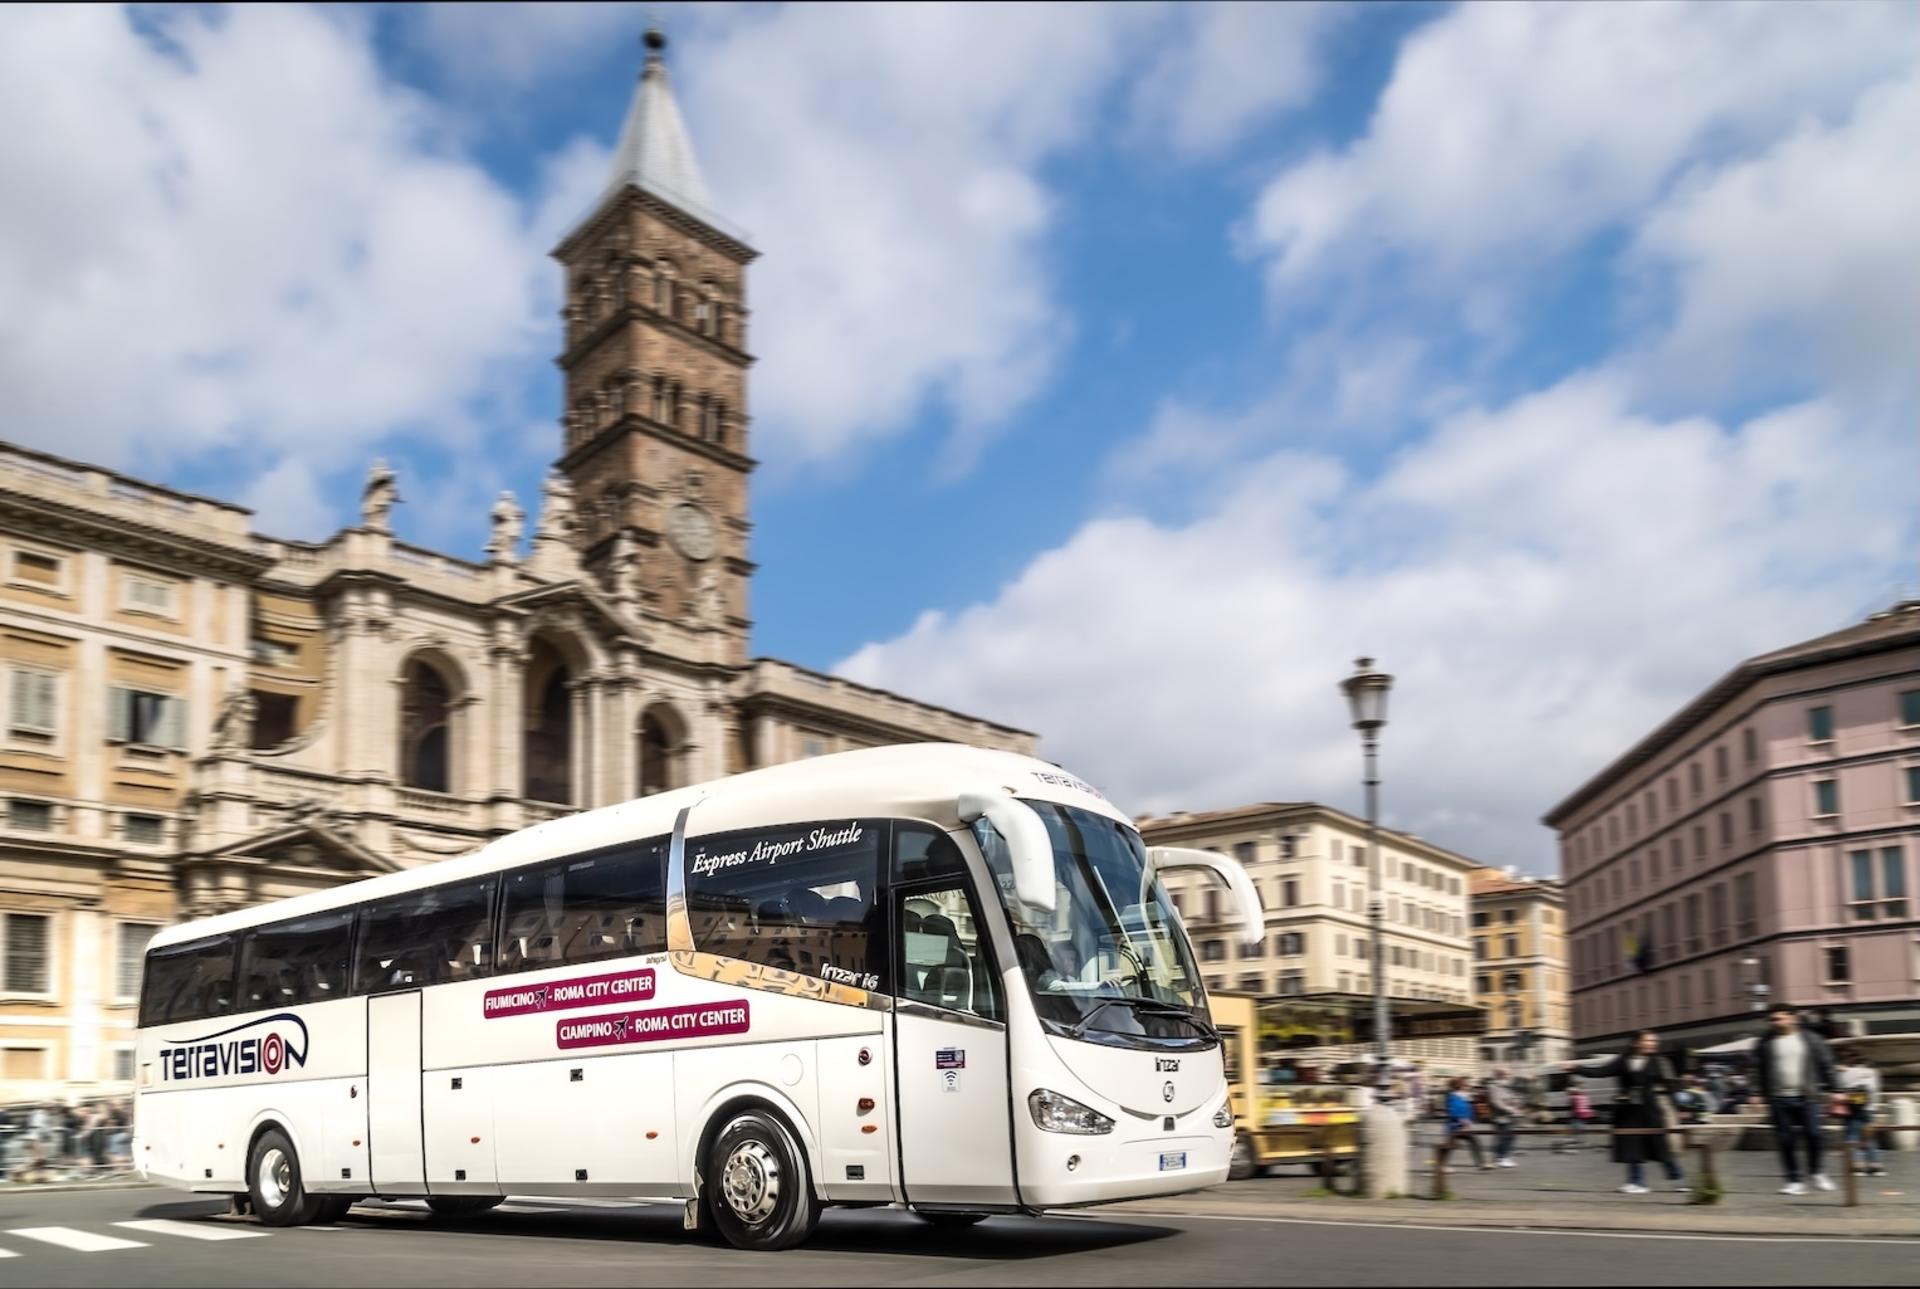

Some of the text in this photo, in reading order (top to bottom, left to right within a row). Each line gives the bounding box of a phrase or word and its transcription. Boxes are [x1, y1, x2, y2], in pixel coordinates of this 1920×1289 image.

[690, 821, 863, 877] Express Airport Shuttle
[485, 991, 535, 1011] FIUMICINO
[553, 986, 584, 1002] ROMA
[586, 981, 610, 997] CITY
[611, 976, 652, 994] CENTER
[560, 1021, 612, 1041] CIAMPINO
[635, 1015, 669, 1033] ROMA
[671, 1012, 697, 1029] CITY
[699, 1008, 746, 1027] CENTER
